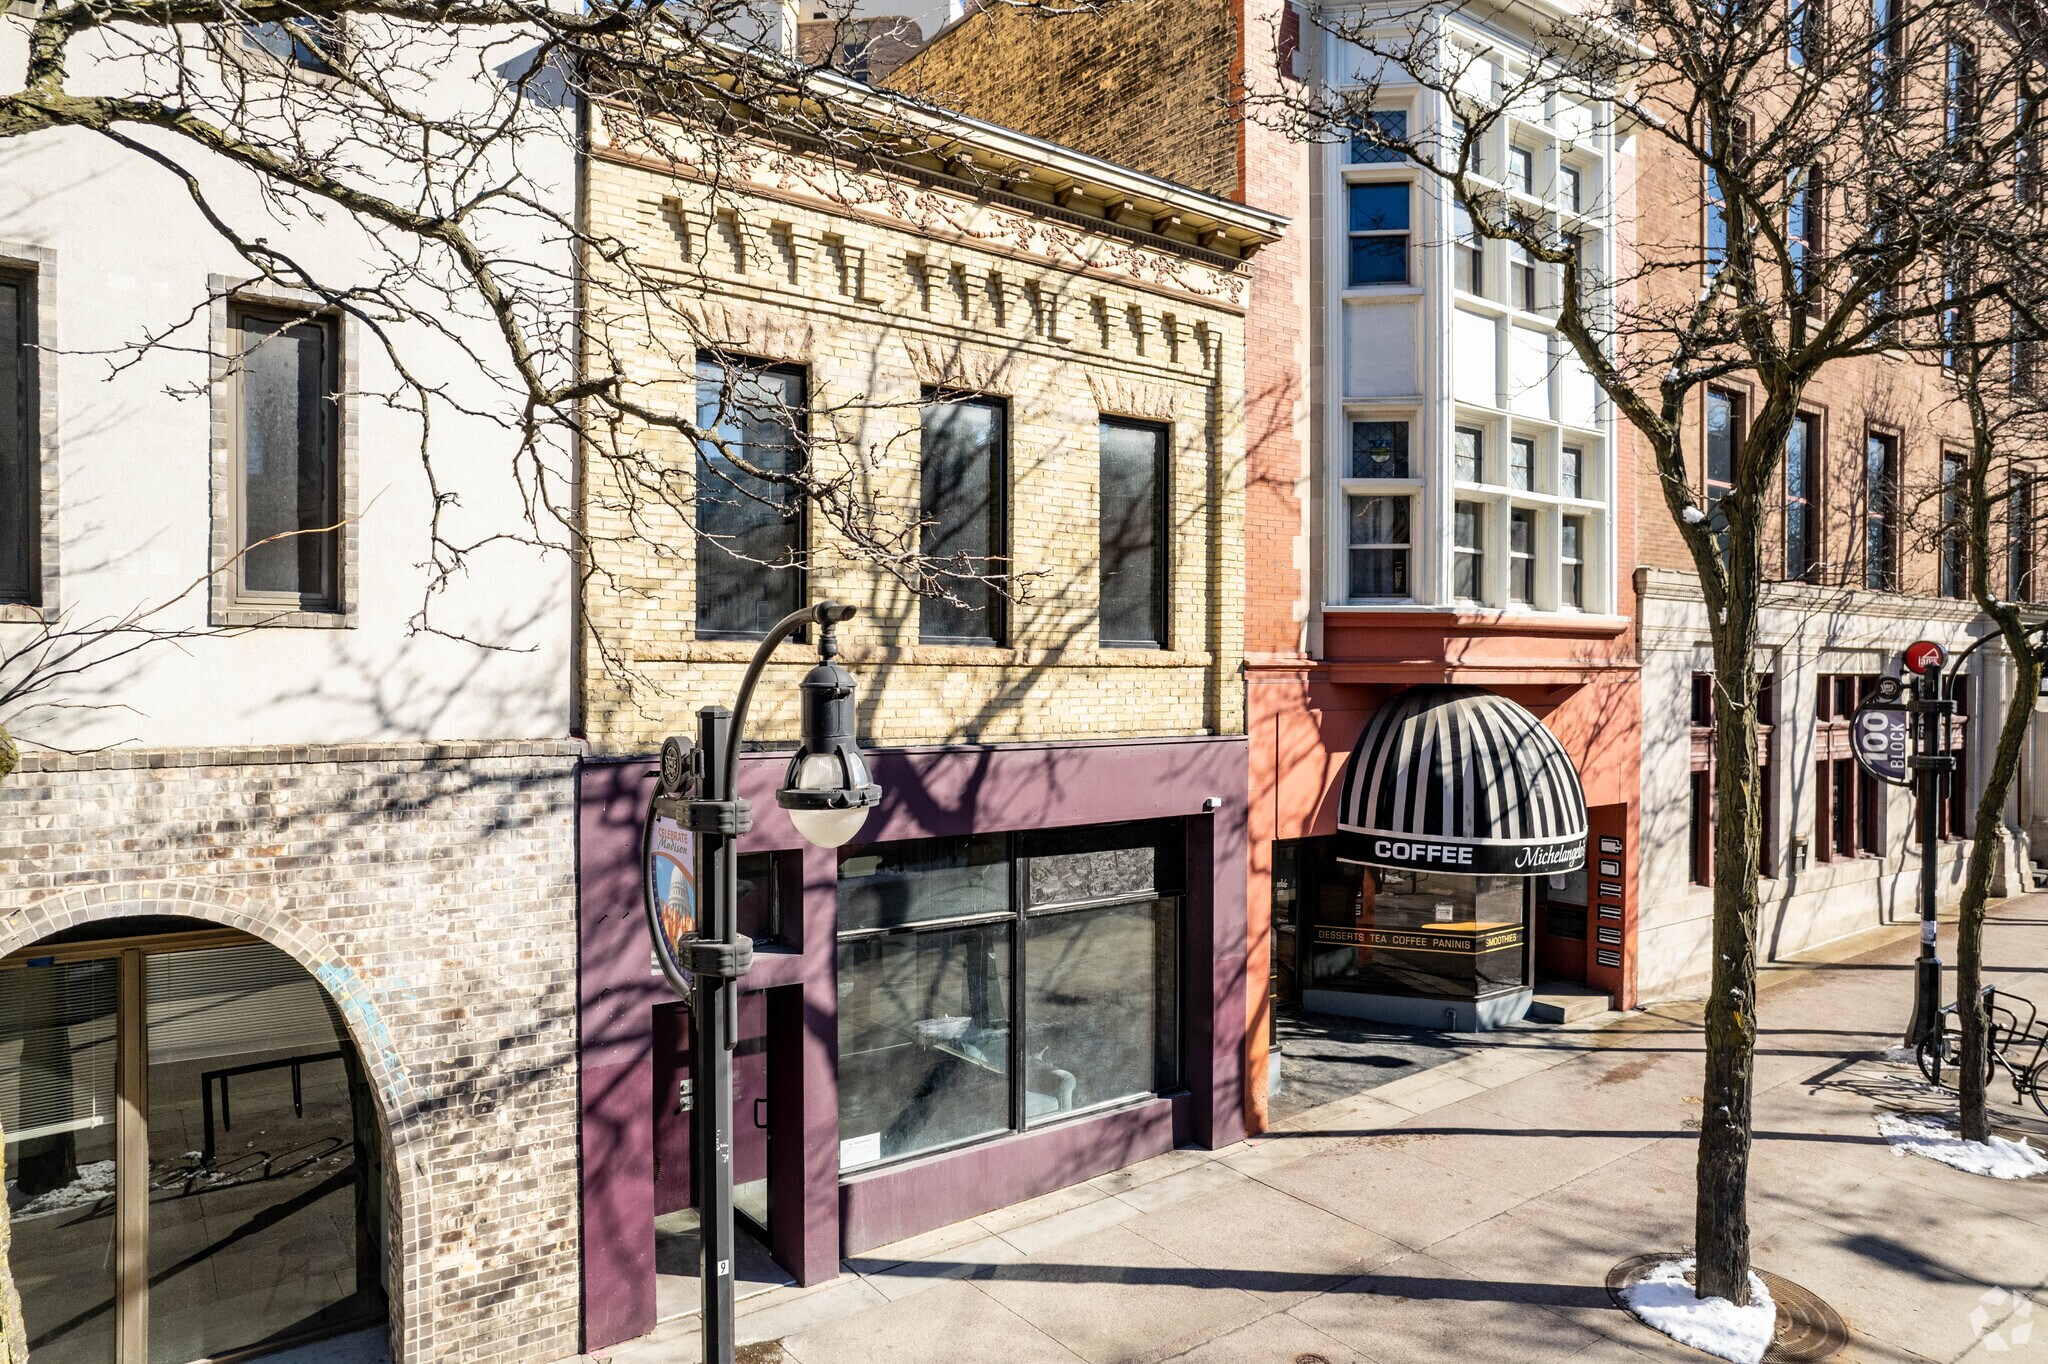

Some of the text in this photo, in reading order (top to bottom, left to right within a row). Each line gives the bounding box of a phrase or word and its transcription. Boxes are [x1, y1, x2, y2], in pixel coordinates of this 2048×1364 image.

[1862, 711, 1889, 765] 100
[1890, 722, 1905, 769] BLOCK
[658, 827, 688, 844] CELEBRATE
[657, 837, 688, 854] Madison
[1374, 840, 1473, 865] COFFEE
[1318, 930, 1471, 950] DESSERTS TEA COFFEE PANINIS
[1485, 933, 1517, 948] SMOOTHIES
[720, 1261, 726, 1274] 9
